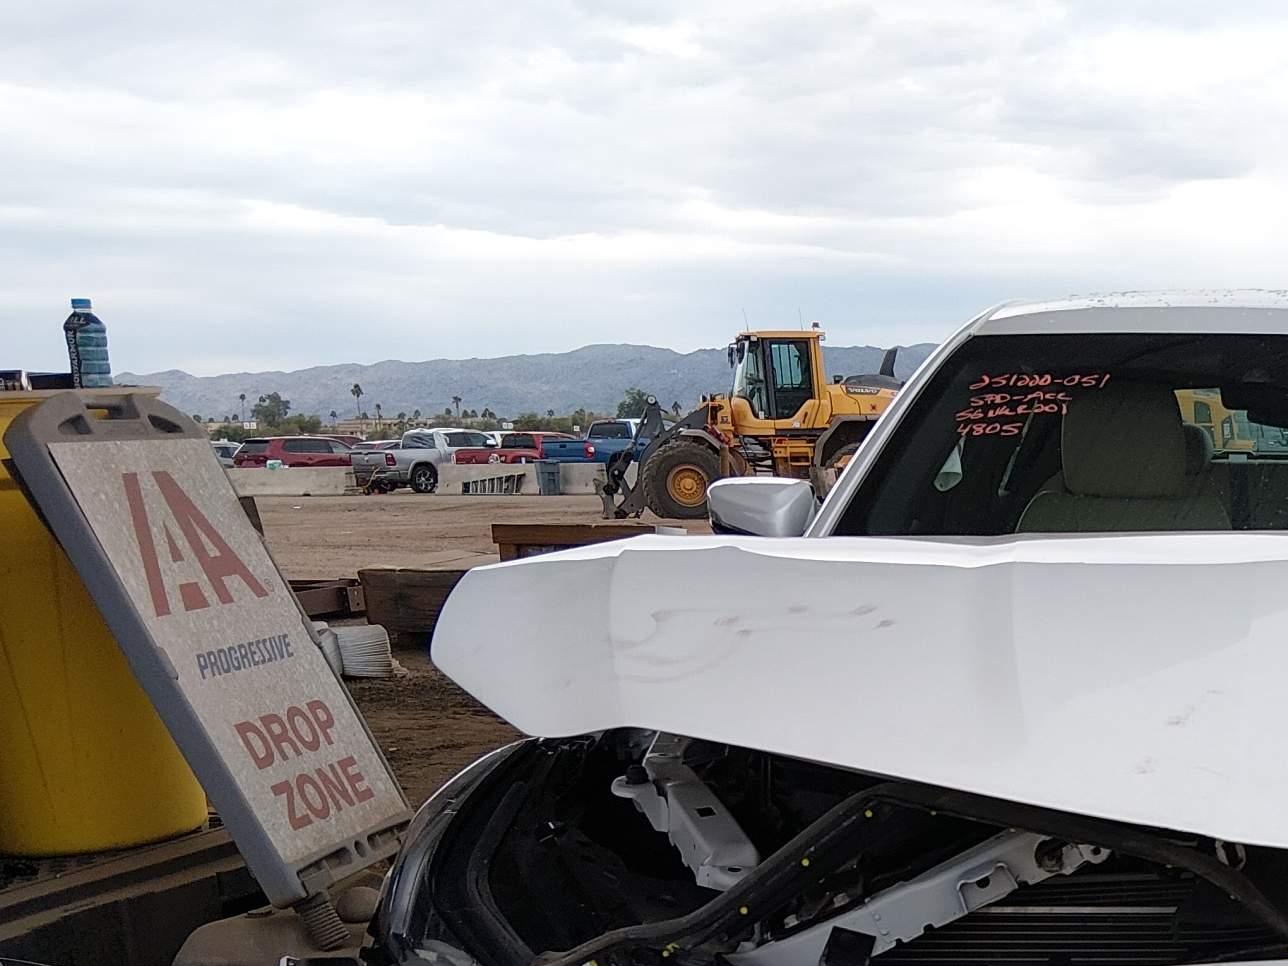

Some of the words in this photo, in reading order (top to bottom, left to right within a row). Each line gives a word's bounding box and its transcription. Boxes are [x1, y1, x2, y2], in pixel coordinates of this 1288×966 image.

[956, 422, 1023, 436] 4805
[196, 633, 294, 680] PROGRESSIVE
[234, 699, 335, 770] DROP
[270, 755, 375, 832] ZONE
